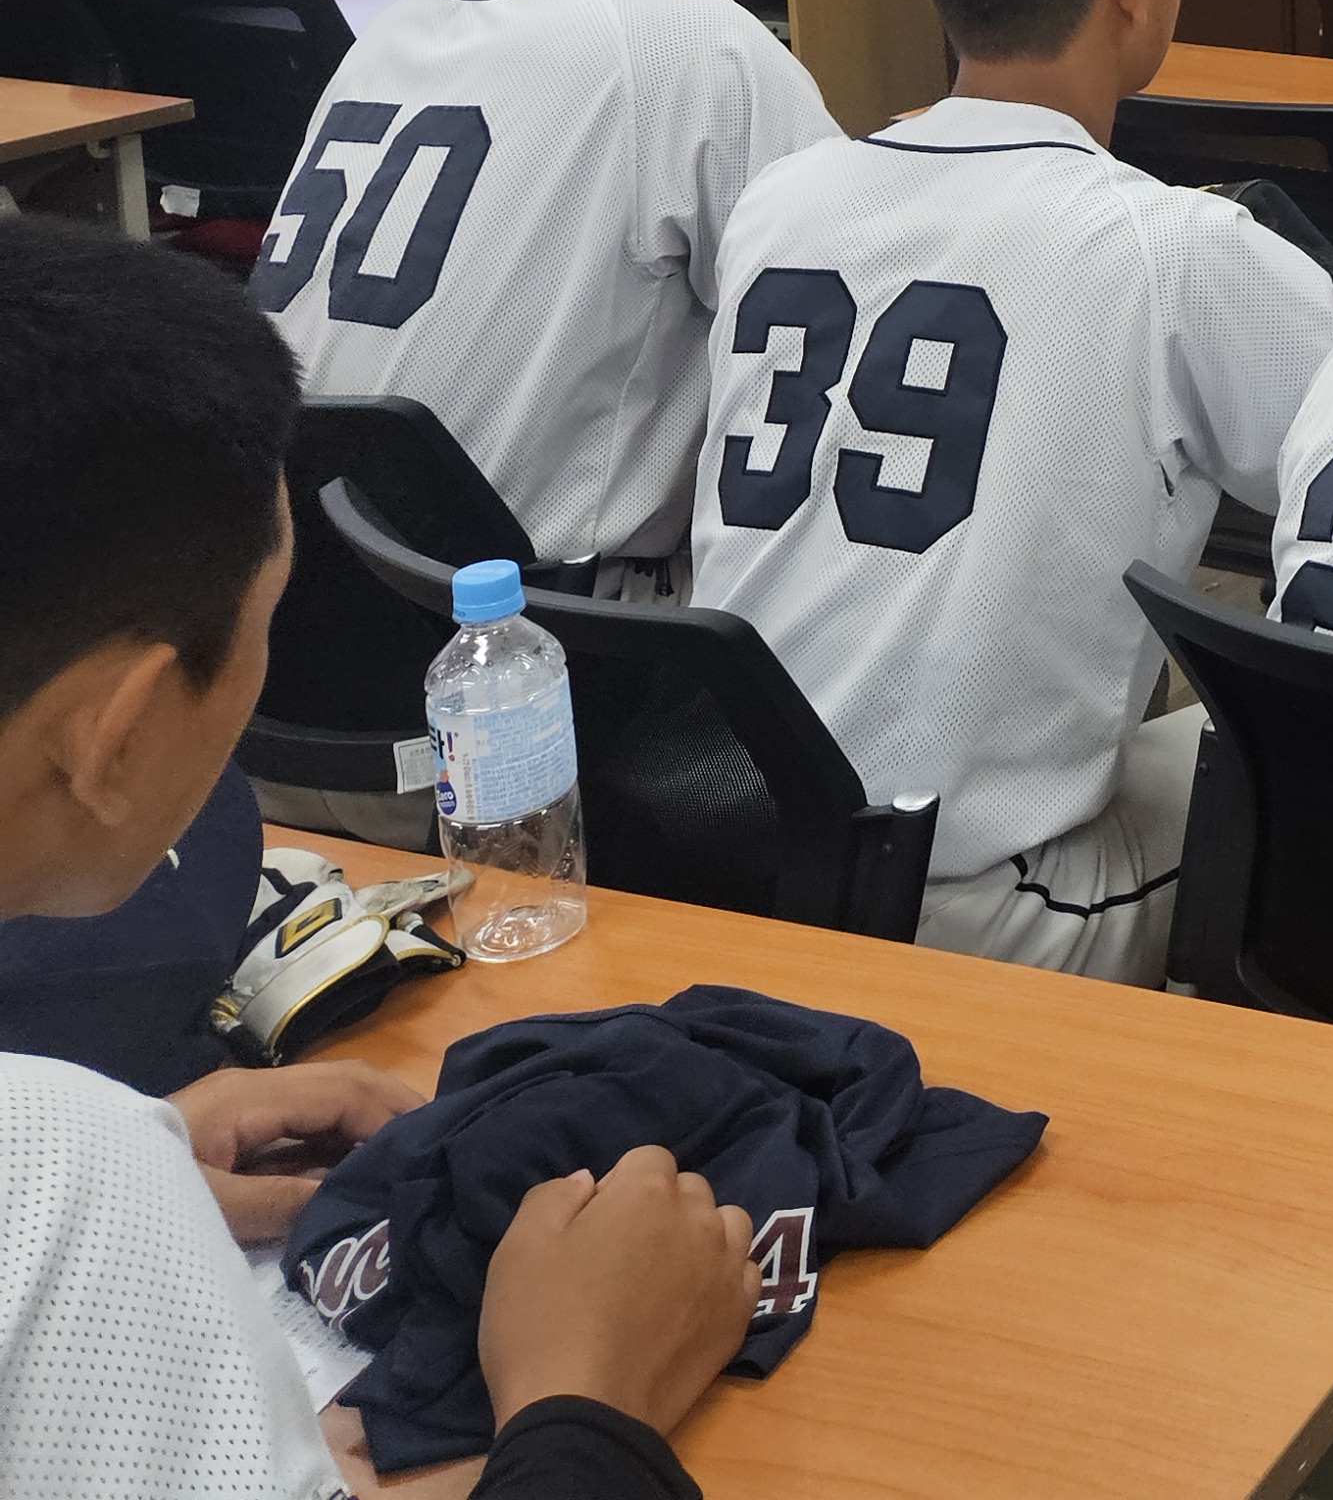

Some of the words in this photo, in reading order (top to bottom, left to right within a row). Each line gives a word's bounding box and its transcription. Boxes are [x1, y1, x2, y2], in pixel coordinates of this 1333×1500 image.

[249, 100, 491, 329] 50
[718, 267, 1009, 554] 39
[747, 1207, 817, 1318] 4
